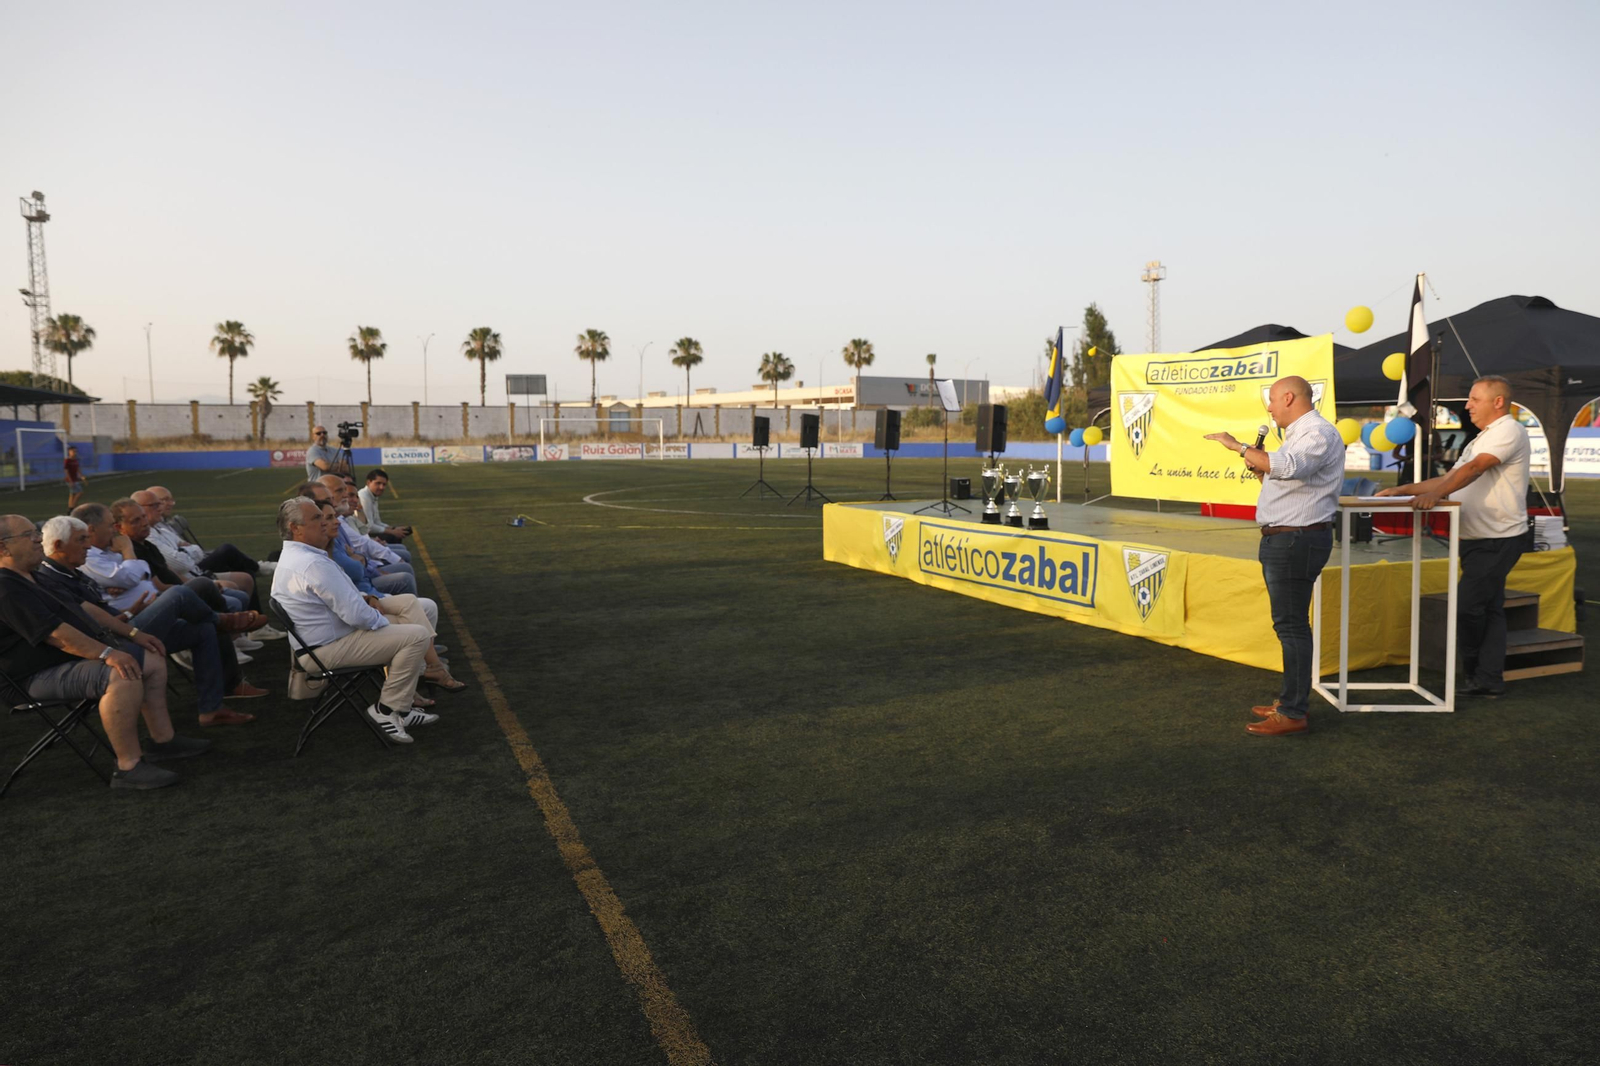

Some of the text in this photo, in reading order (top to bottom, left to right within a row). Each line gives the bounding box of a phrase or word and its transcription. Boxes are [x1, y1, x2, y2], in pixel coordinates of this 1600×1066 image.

[1175, 387, 1208, 395] FUNDADO
[1220, 384, 1236, 393] 1980
[582, 445, 606, 455] Ruiz
[1149, 462, 1258, 484] La unión hace la fue
[923, 533, 1090, 598] atléticozabal
